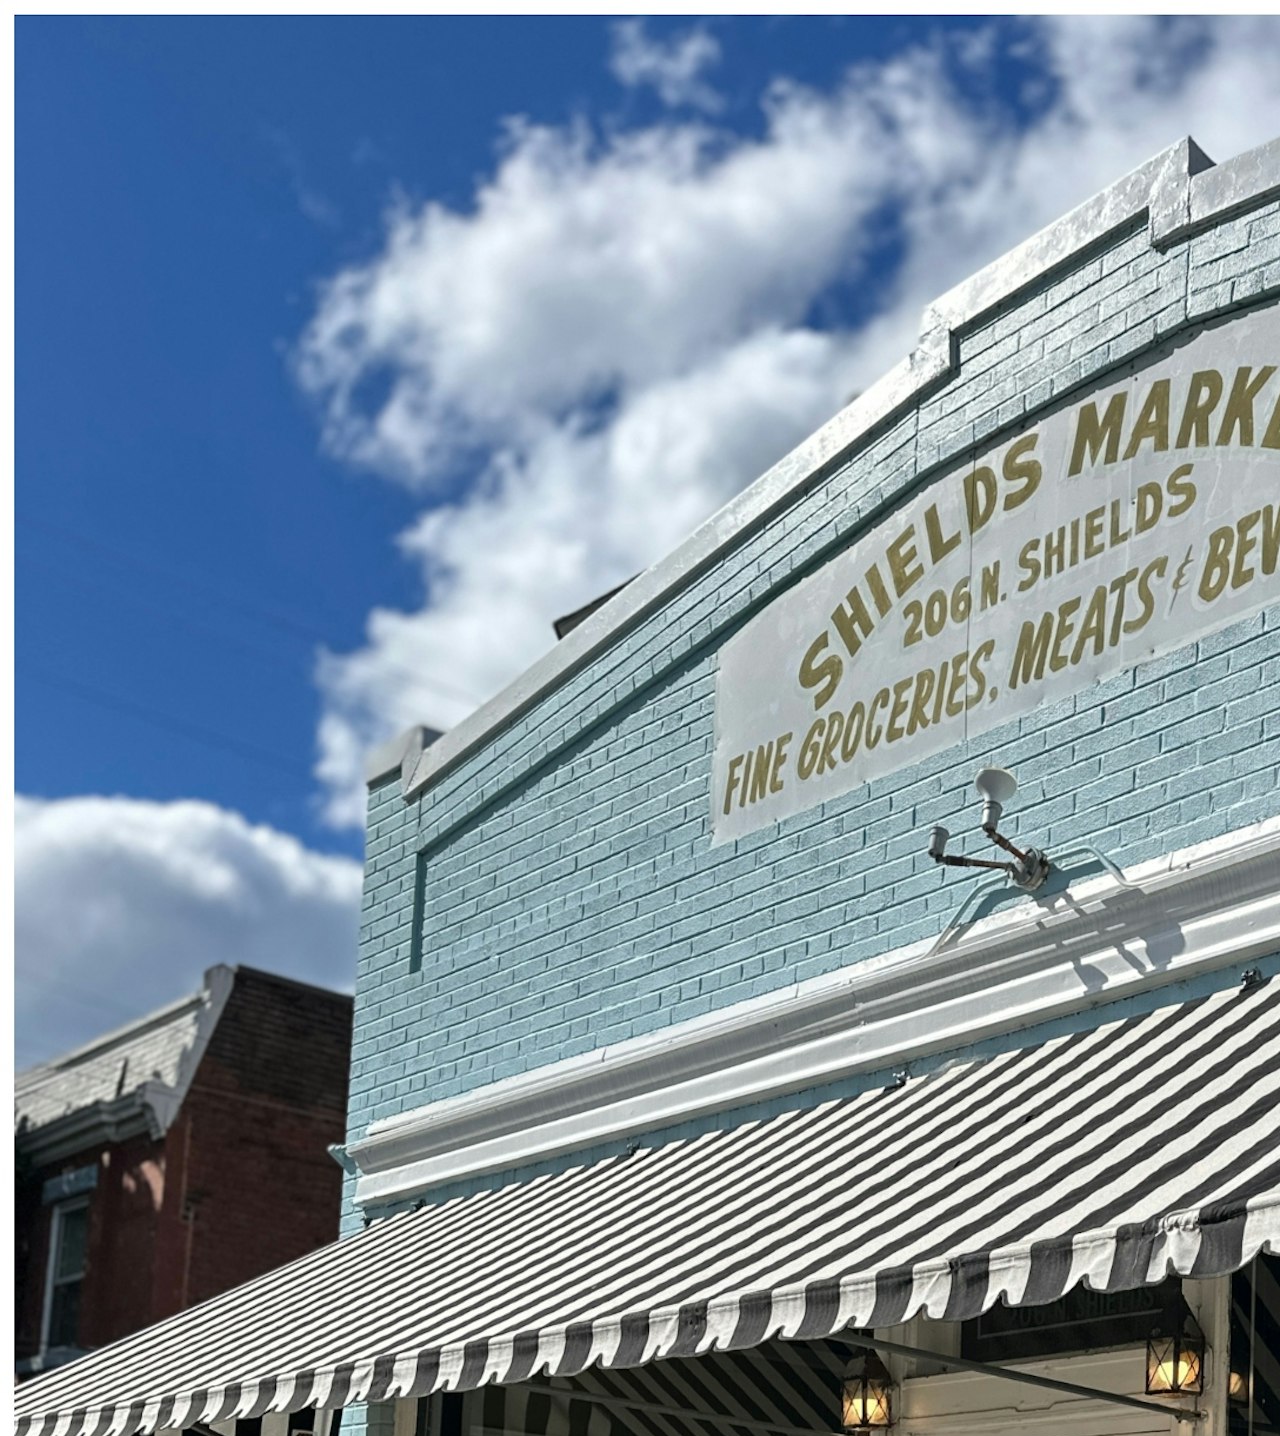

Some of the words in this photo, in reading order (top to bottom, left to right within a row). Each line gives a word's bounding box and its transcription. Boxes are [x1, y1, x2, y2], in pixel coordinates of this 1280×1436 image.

[722, 730, 794, 815] FINE
[797, 638, 998, 782] GROCERIES,
[1008, 555, 1169, 690] MEATS
[798, 432, 1043, 711] SHIELDS
[901, 576, 973, 648] 206
[1016, 462, 1199, 592] SHIELDS
